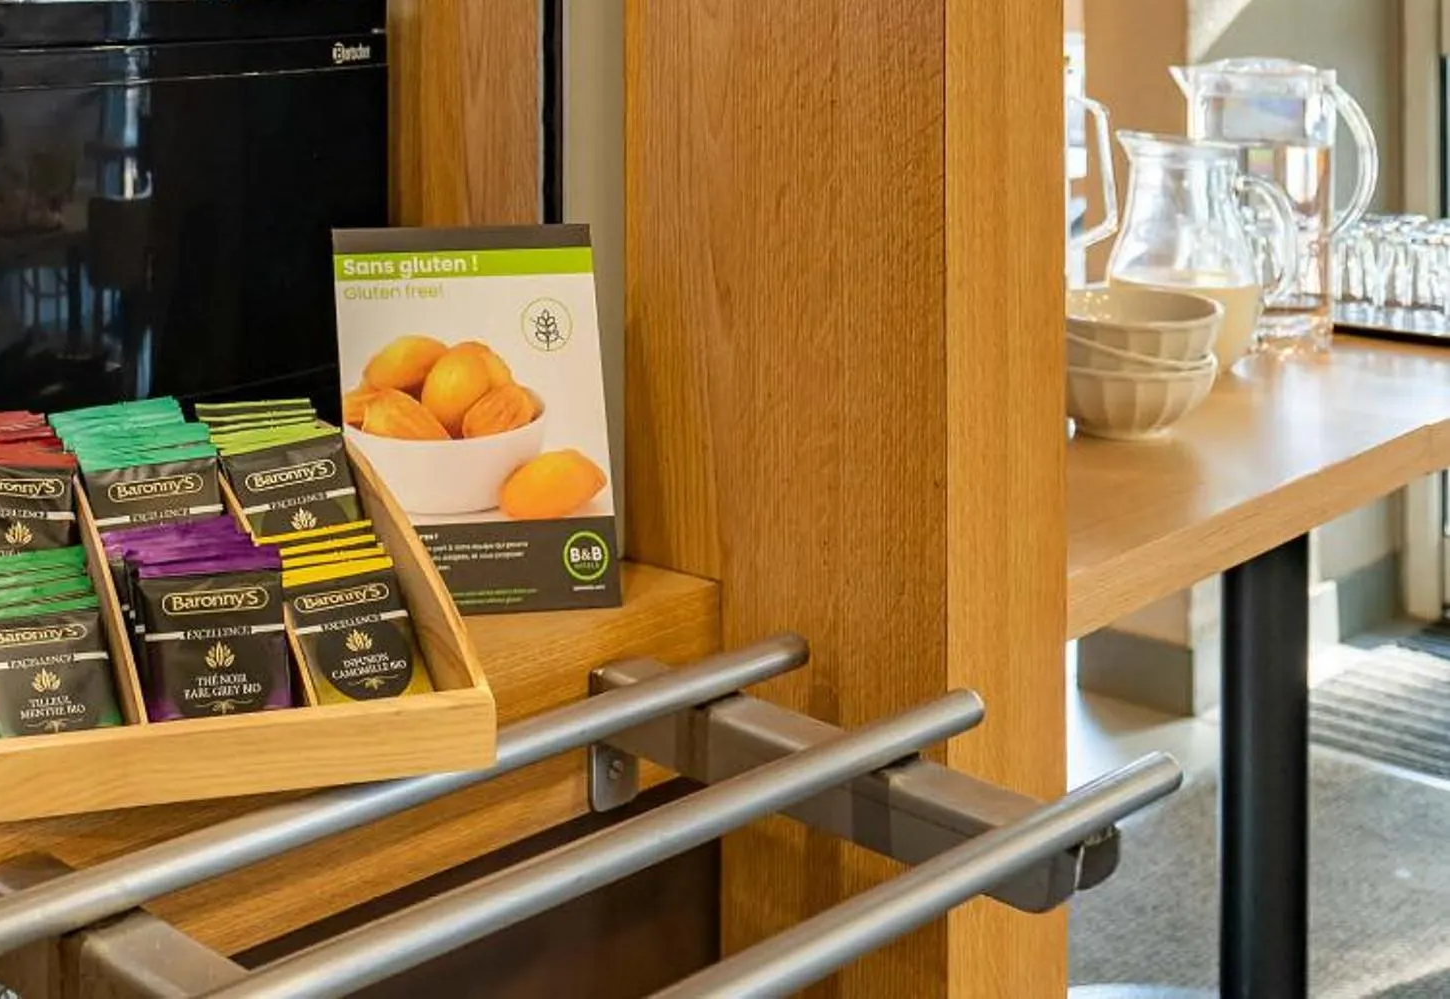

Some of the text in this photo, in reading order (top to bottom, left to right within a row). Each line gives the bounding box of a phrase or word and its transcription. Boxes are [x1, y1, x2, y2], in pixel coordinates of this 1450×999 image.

[343, 258, 395, 275] Sans
[399, 255, 467, 278] gluten
[343, 285, 401, 300] Gluten
[270, 491, 325, 510] EXCELLENCE
[570, 545, 603, 563] B&B
[323, 613, 380, 632] EXCELLENCE
[186, 625, 250, 641] EXCELLENCE
[11, 653, 72, 669] EXCELLENCE
[343, 652, 390, 669] INFUSION
[331, 659, 408, 680] CAMOMILLE BIO
[219, 673, 248, 684] NOIR
[183, 682, 262, 701] EARL GREY BIO
[20, 703, 86, 720] MENTHE BIO
